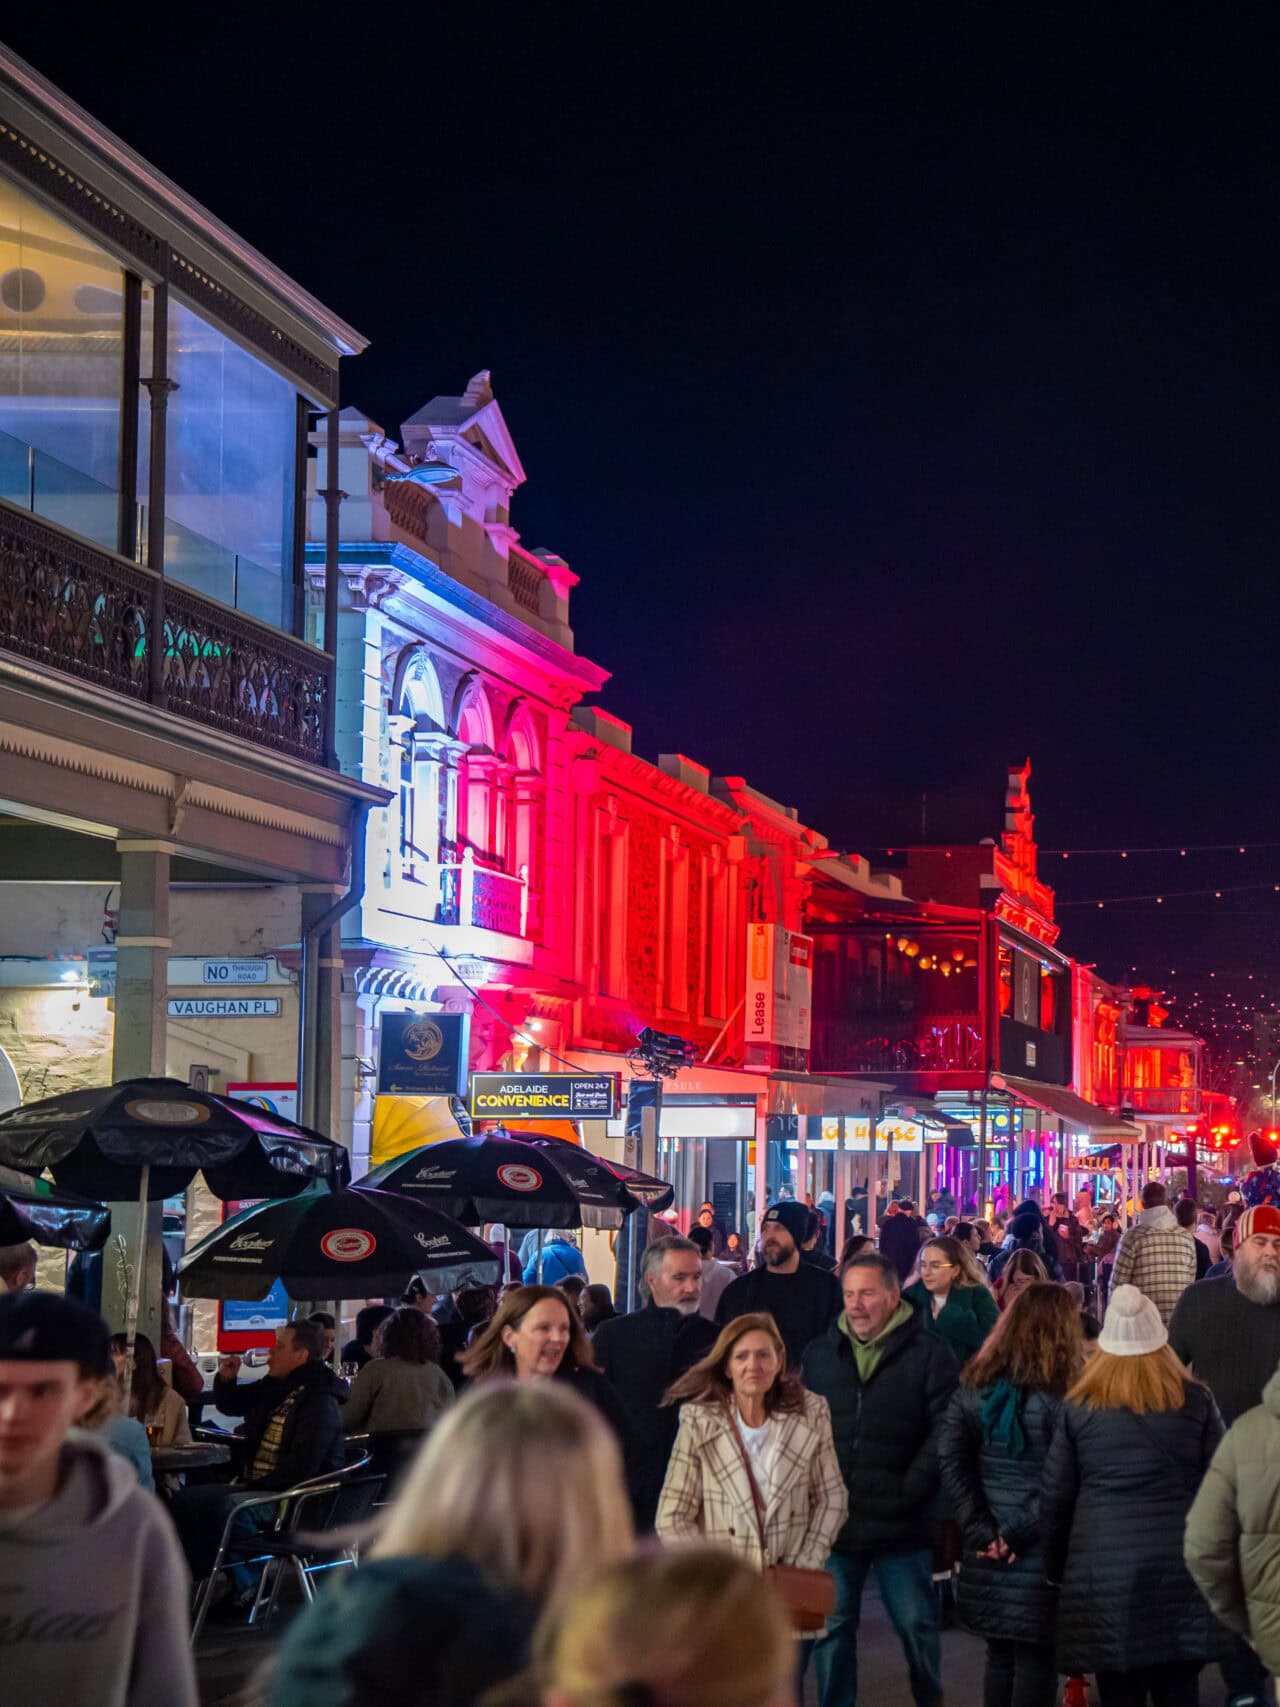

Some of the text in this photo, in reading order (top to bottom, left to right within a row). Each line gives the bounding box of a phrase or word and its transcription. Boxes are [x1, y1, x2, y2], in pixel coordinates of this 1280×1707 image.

[207, 966, 228, 979] NO
[232, 964, 264, 972] THROUGH
[174, 1002, 248, 1013] VAUGHAN
[752, 991, 765, 1035] Lease
[499, 1085, 549, 1094] ADELAIDE
[476, 1095, 570, 1107] CONVENIENCE
